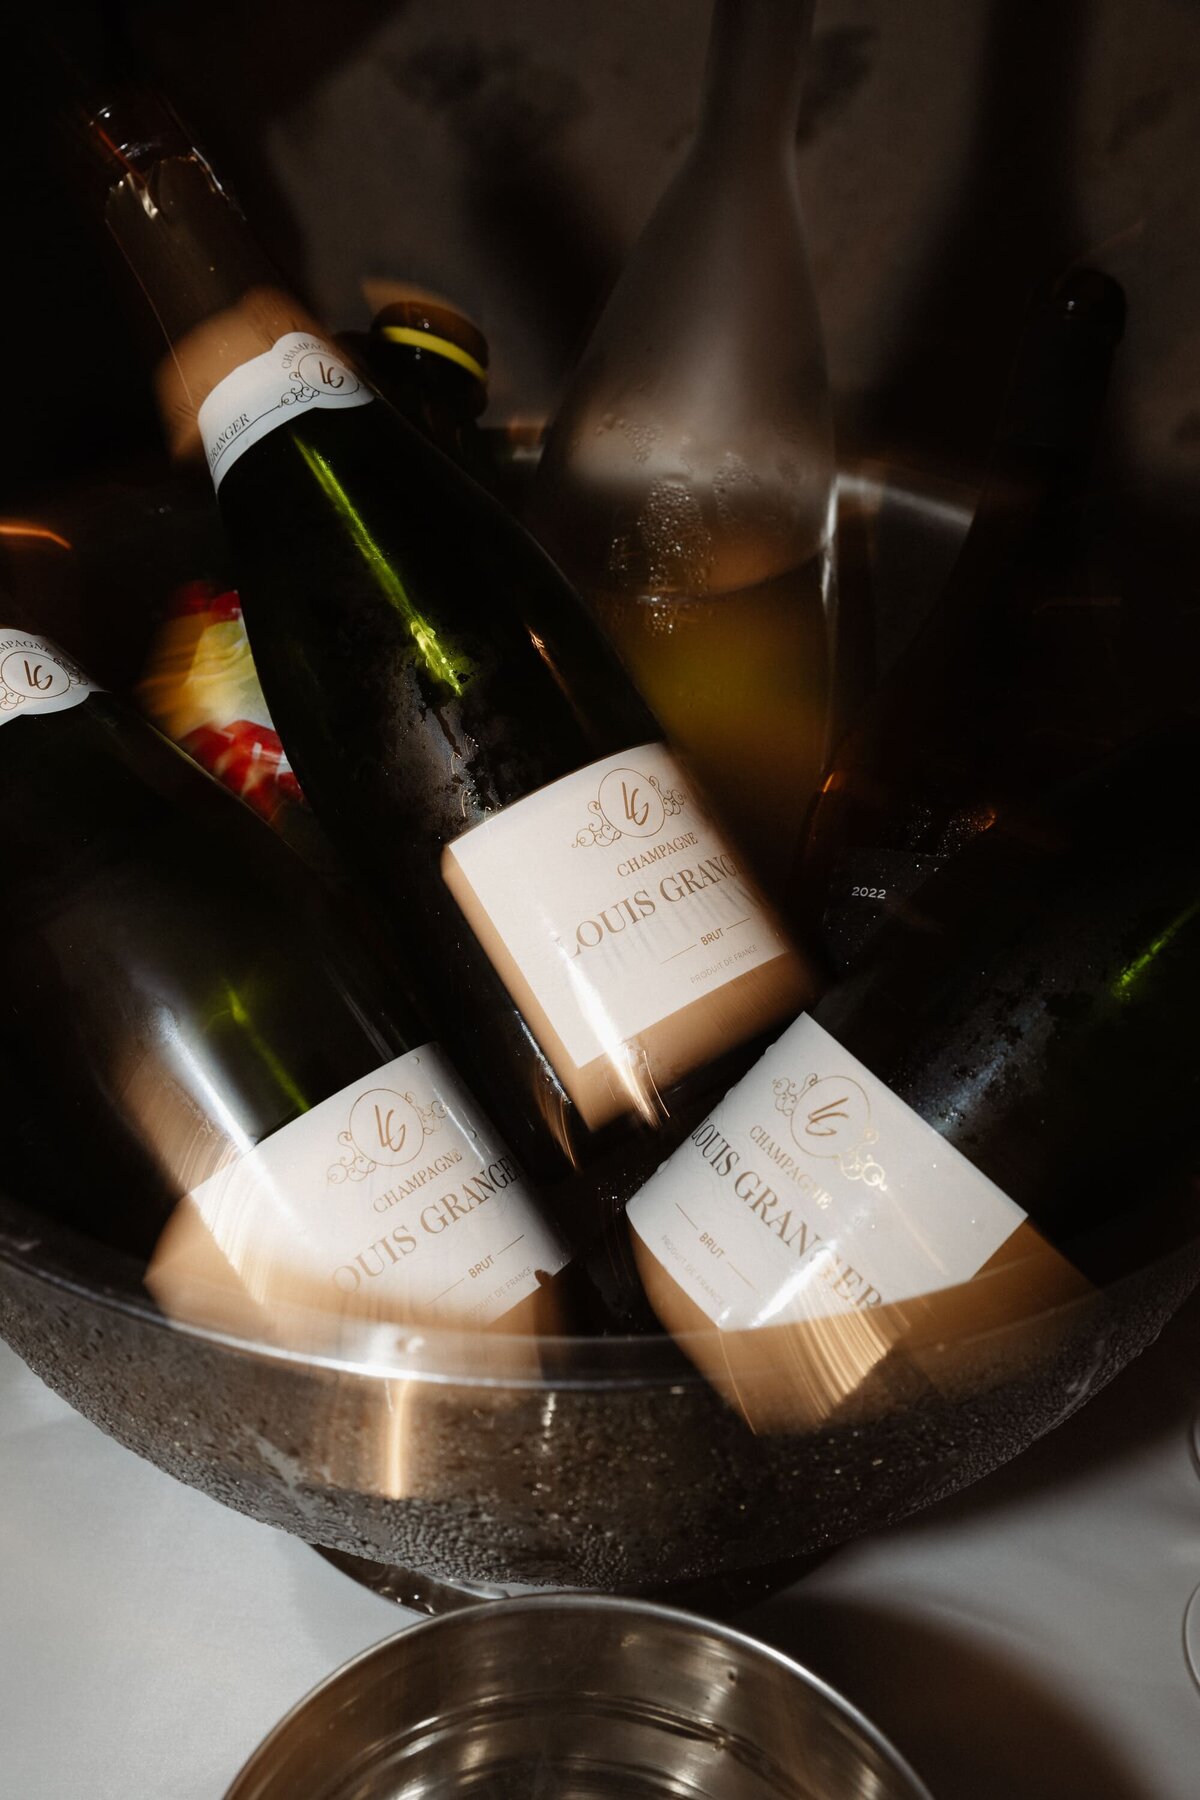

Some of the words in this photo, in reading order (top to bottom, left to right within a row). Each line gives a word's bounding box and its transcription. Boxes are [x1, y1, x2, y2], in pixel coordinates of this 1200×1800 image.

[616, 832, 699, 878] CHAMPAGNE
[555, 889, 656, 960] OUIS
[659, 853, 739, 903] GRANG
[851, 886, 887, 900] 2022
[700, 927, 725, 946] BRUT
[690, 962, 723, 984] PRODUIT
[723, 955, 735, 967] DE
[733, 944, 759, 961] FRANCE
[372, 1148, 464, 1214] CHAMPAGNE
[331, 1224, 418, 1292] OUIS
[699, 1231, 726, 1259] BRUT
[468, 1254, 495, 1279] BRUT
[505, 1265, 533, 1290] FRANCE
